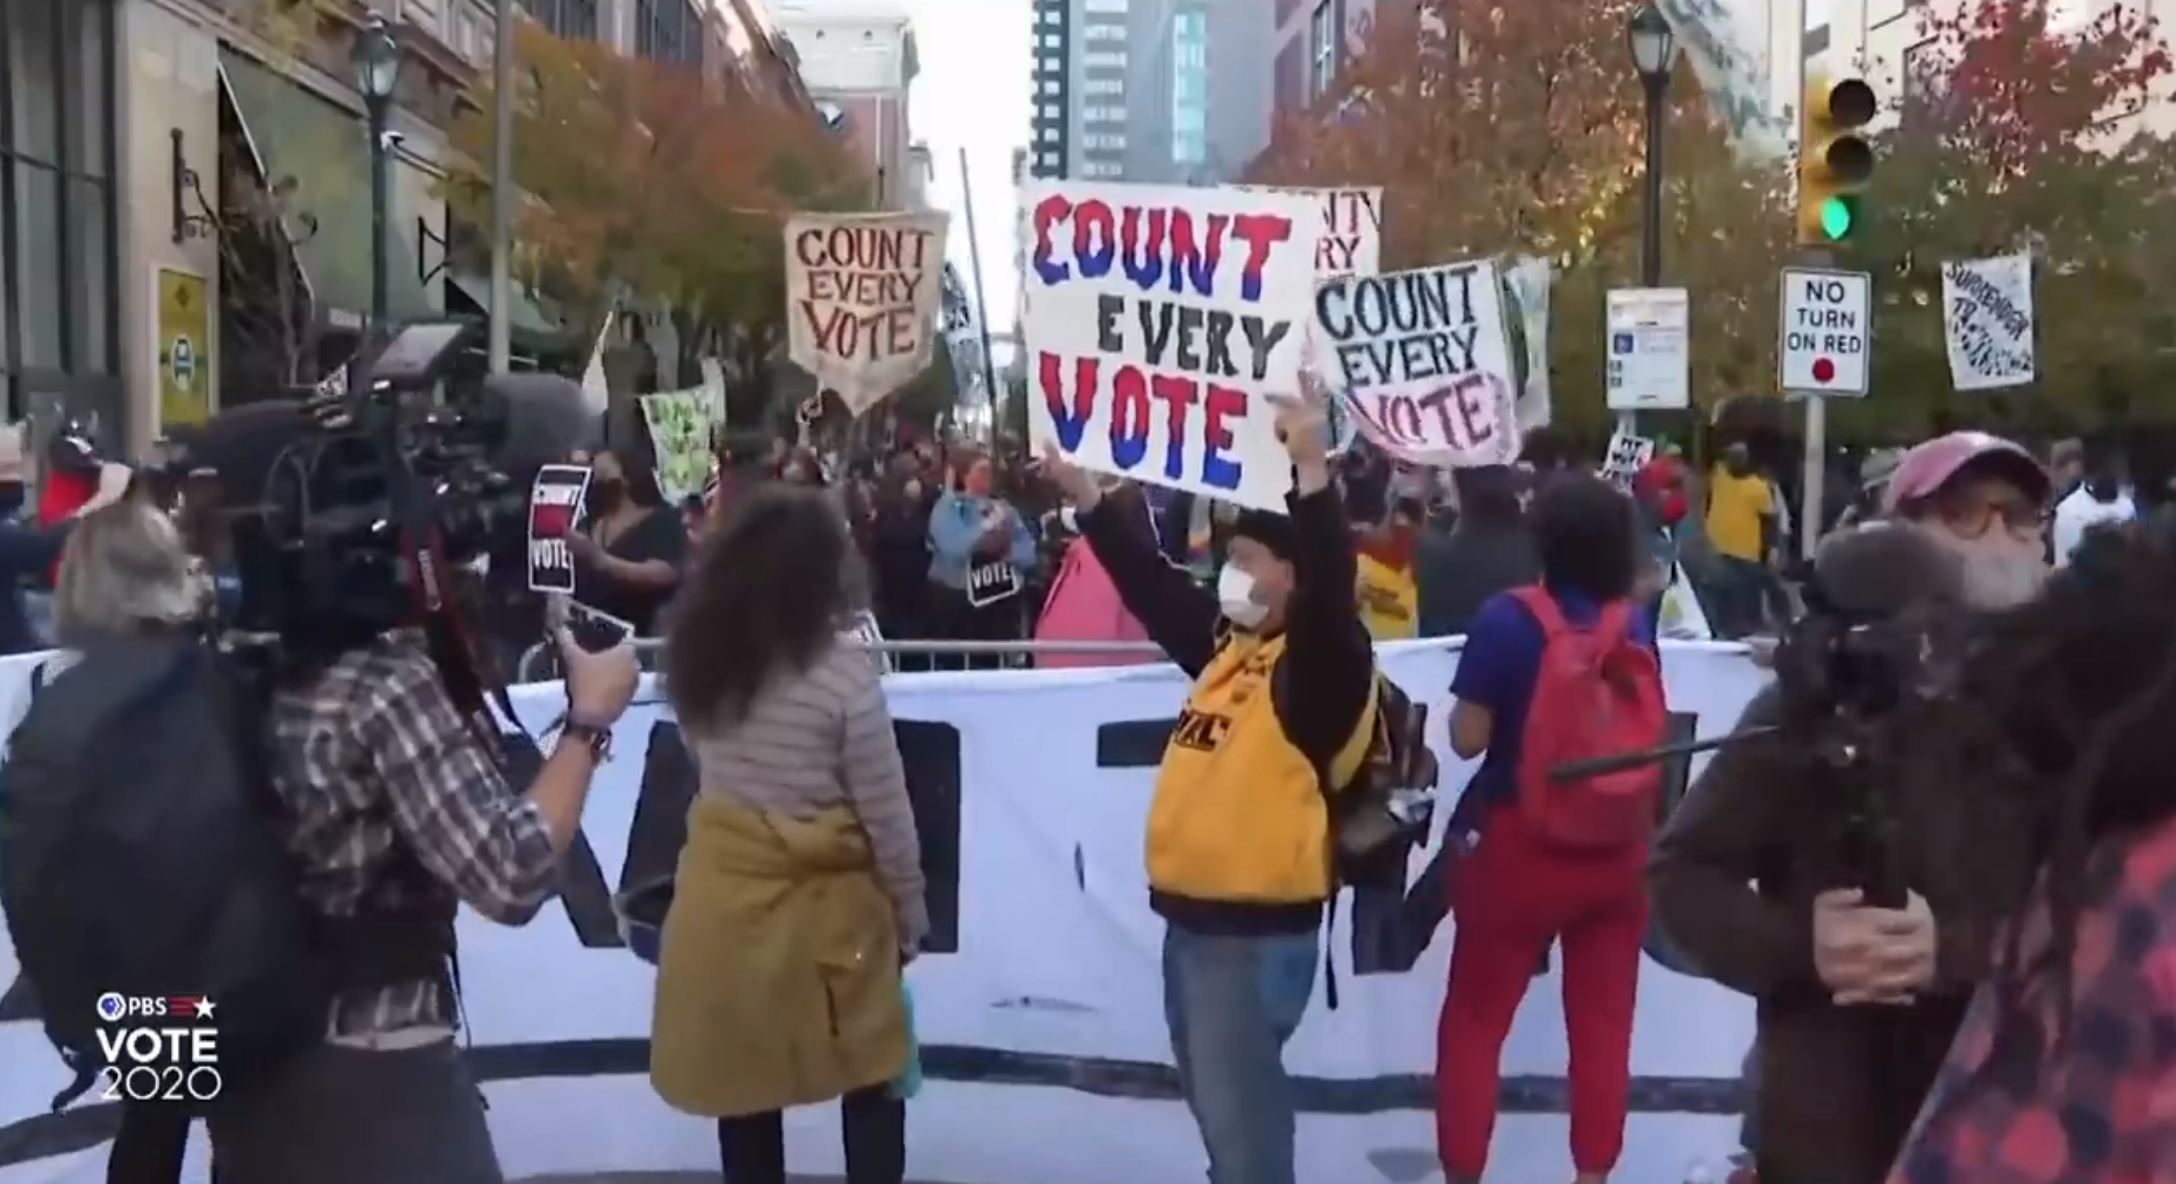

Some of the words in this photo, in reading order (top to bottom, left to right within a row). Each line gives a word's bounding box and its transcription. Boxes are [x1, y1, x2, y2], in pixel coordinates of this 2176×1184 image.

[797, 227, 935, 270] COUNT
[1033, 194, 1293, 302] COUNT
[808, 270, 922, 306] EVERY
[1315, 265, 1478, 341] COUNT
[1806, 280, 1845, 304] NO
[799, 299, 916, 362] VOTE
[1796, 307, 1856, 330] TURN
[1336, 326, 1479, 387] EVERY
[1787, 332, 1816, 351] ON
[1824, 334, 1861, 354] RED
[1039, 350, 1249, 491] VOTE
[1347, 374, 1493, 450] VOTE
[532, 539, 570, 569] VOTE
[971, 561, 1012, 589] VOTE
